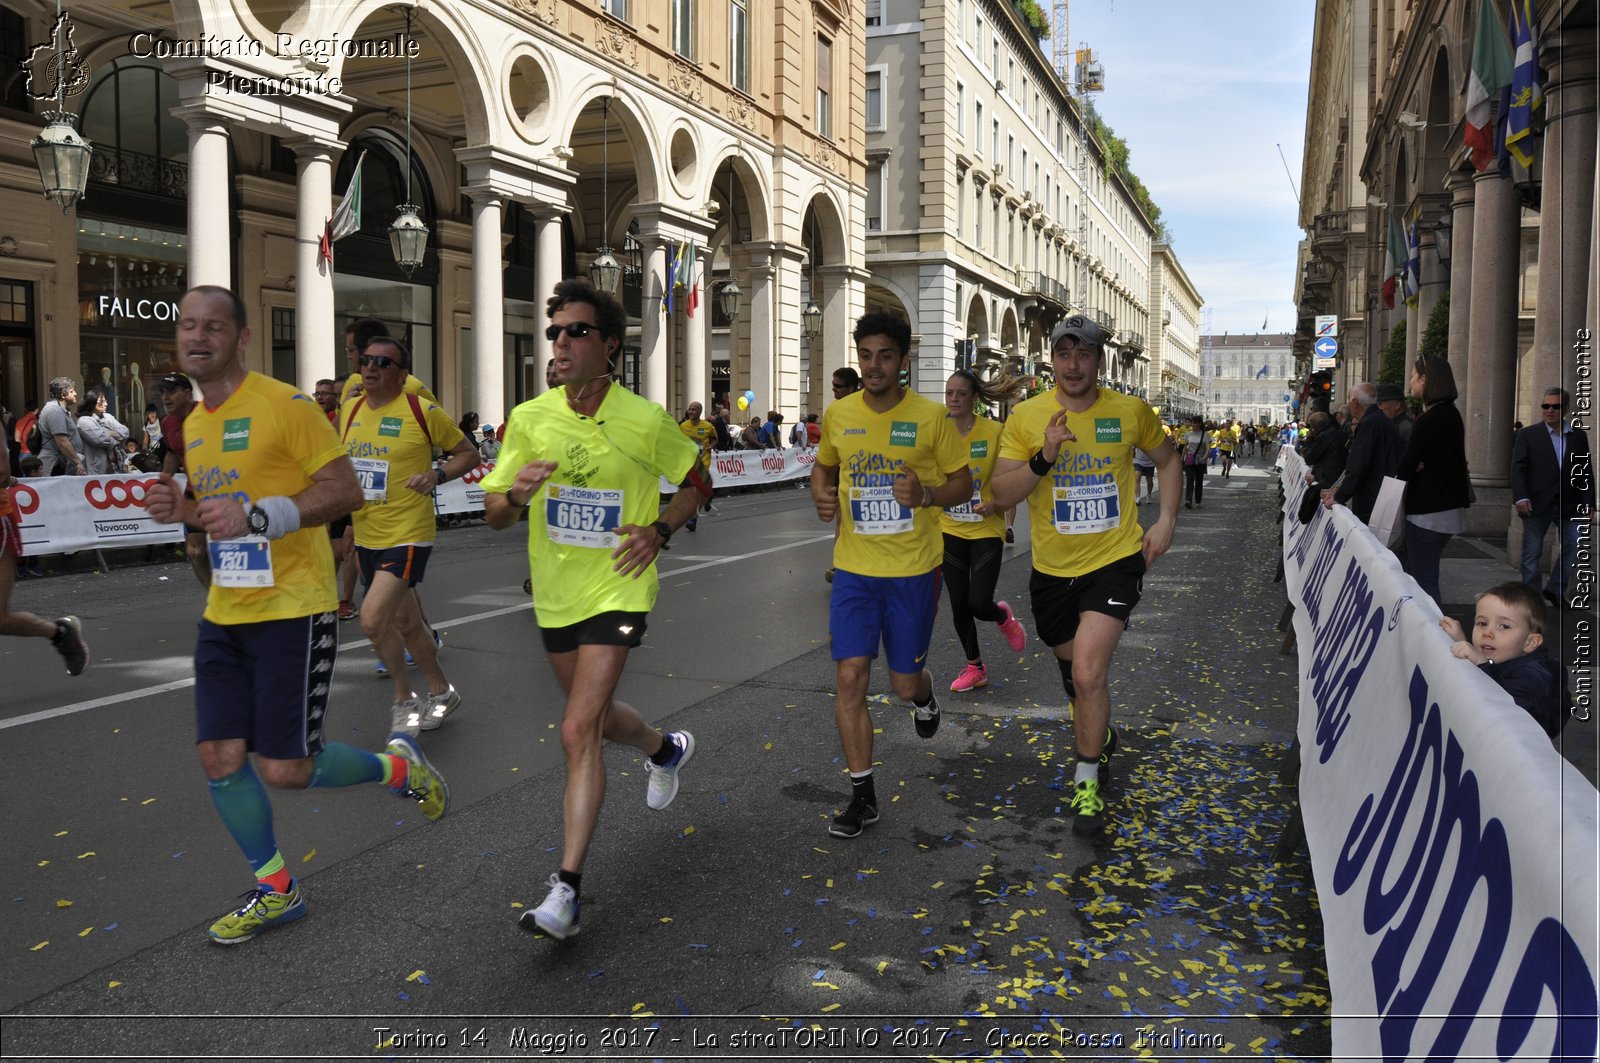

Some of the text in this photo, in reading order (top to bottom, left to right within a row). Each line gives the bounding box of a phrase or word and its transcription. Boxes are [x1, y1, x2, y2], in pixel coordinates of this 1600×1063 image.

[99, 295, 181, 321] FALCON
[891, 429, 917, 438] Arredo3
[716, 454, 746, 477] inalpi
[357, 471, 375, 489] 76
[849, 473, 907, 488] TORIN
[557, 502, 606, 532] 6652
[860, 500, 901, 521] 5990
[1067, 499, 1108, 521] 7380
[95, 522, 140, 532] Novacoop
[218, 551, 249, 570] 2527
